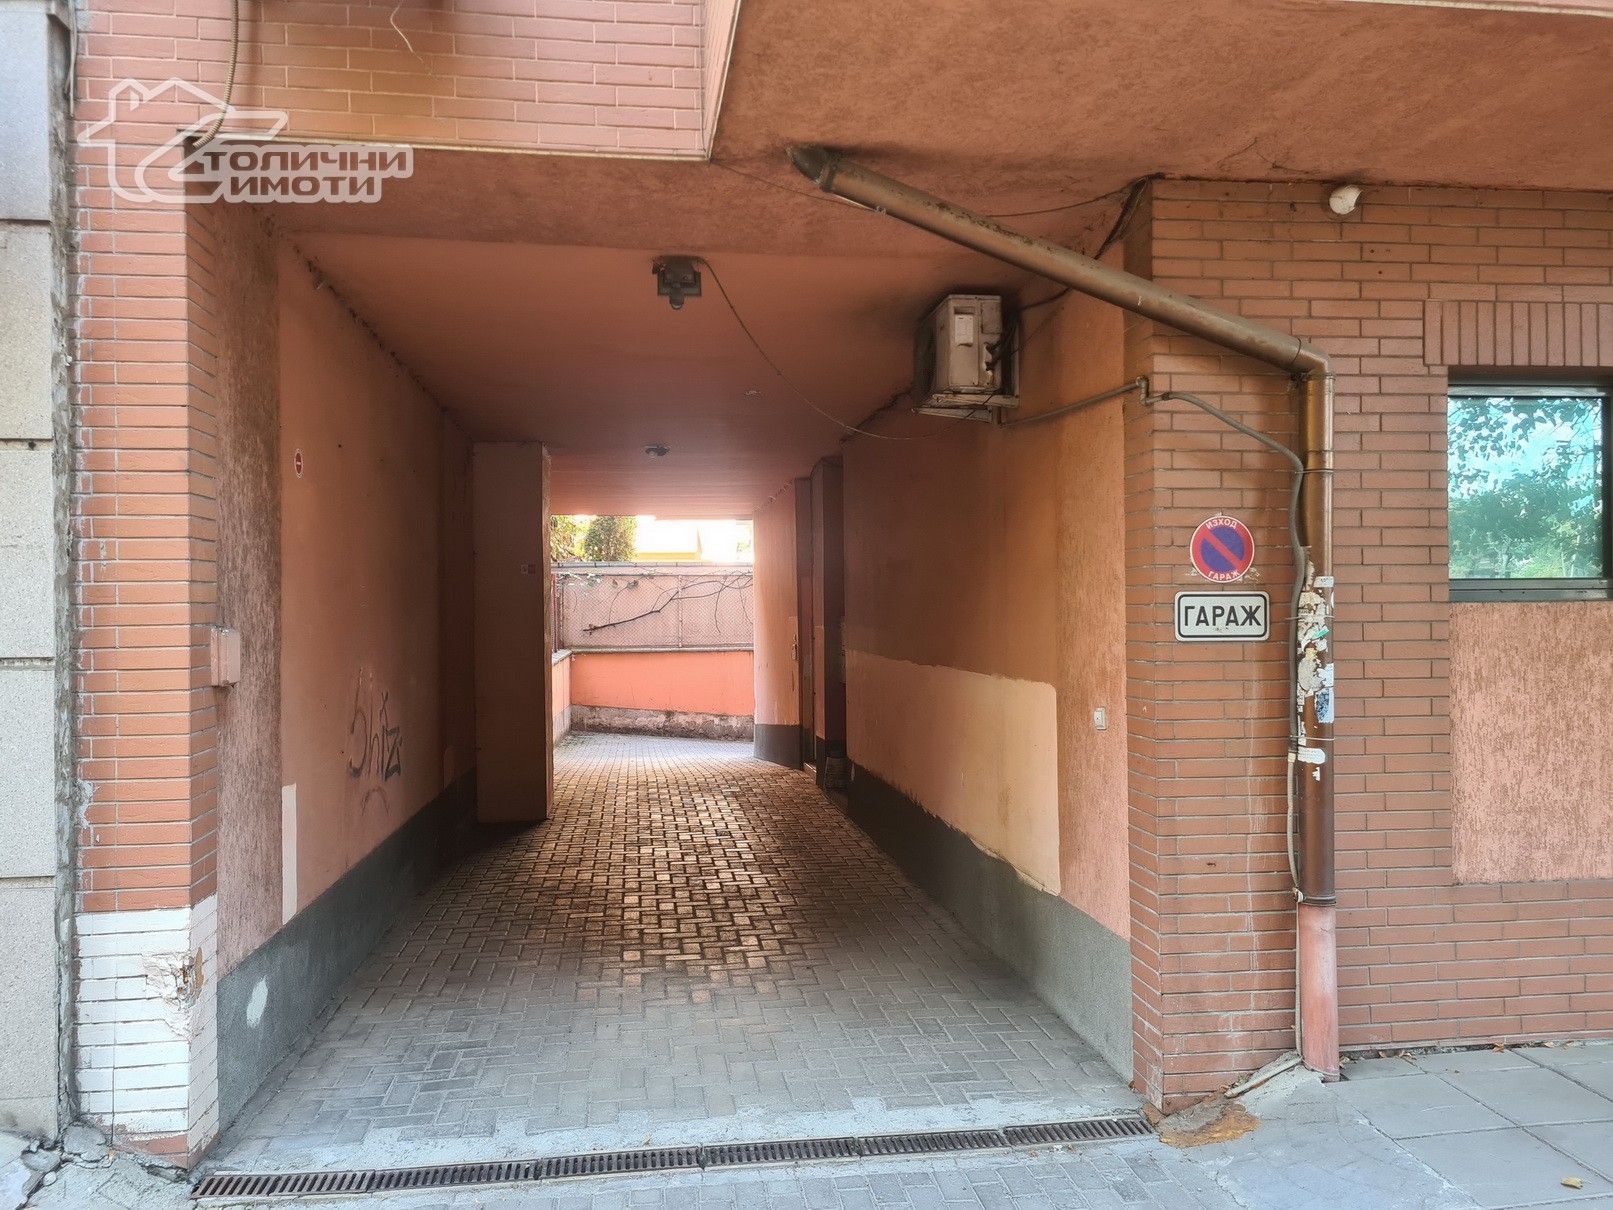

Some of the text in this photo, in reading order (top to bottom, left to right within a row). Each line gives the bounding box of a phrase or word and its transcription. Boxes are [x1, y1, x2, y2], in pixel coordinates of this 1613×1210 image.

[1205, 518, 1238, 530] ИЗХОД
[1207, 569, 1240, 581] ГАРАЖ
[1184, 605, 1262, 627] ГАРАЖ
